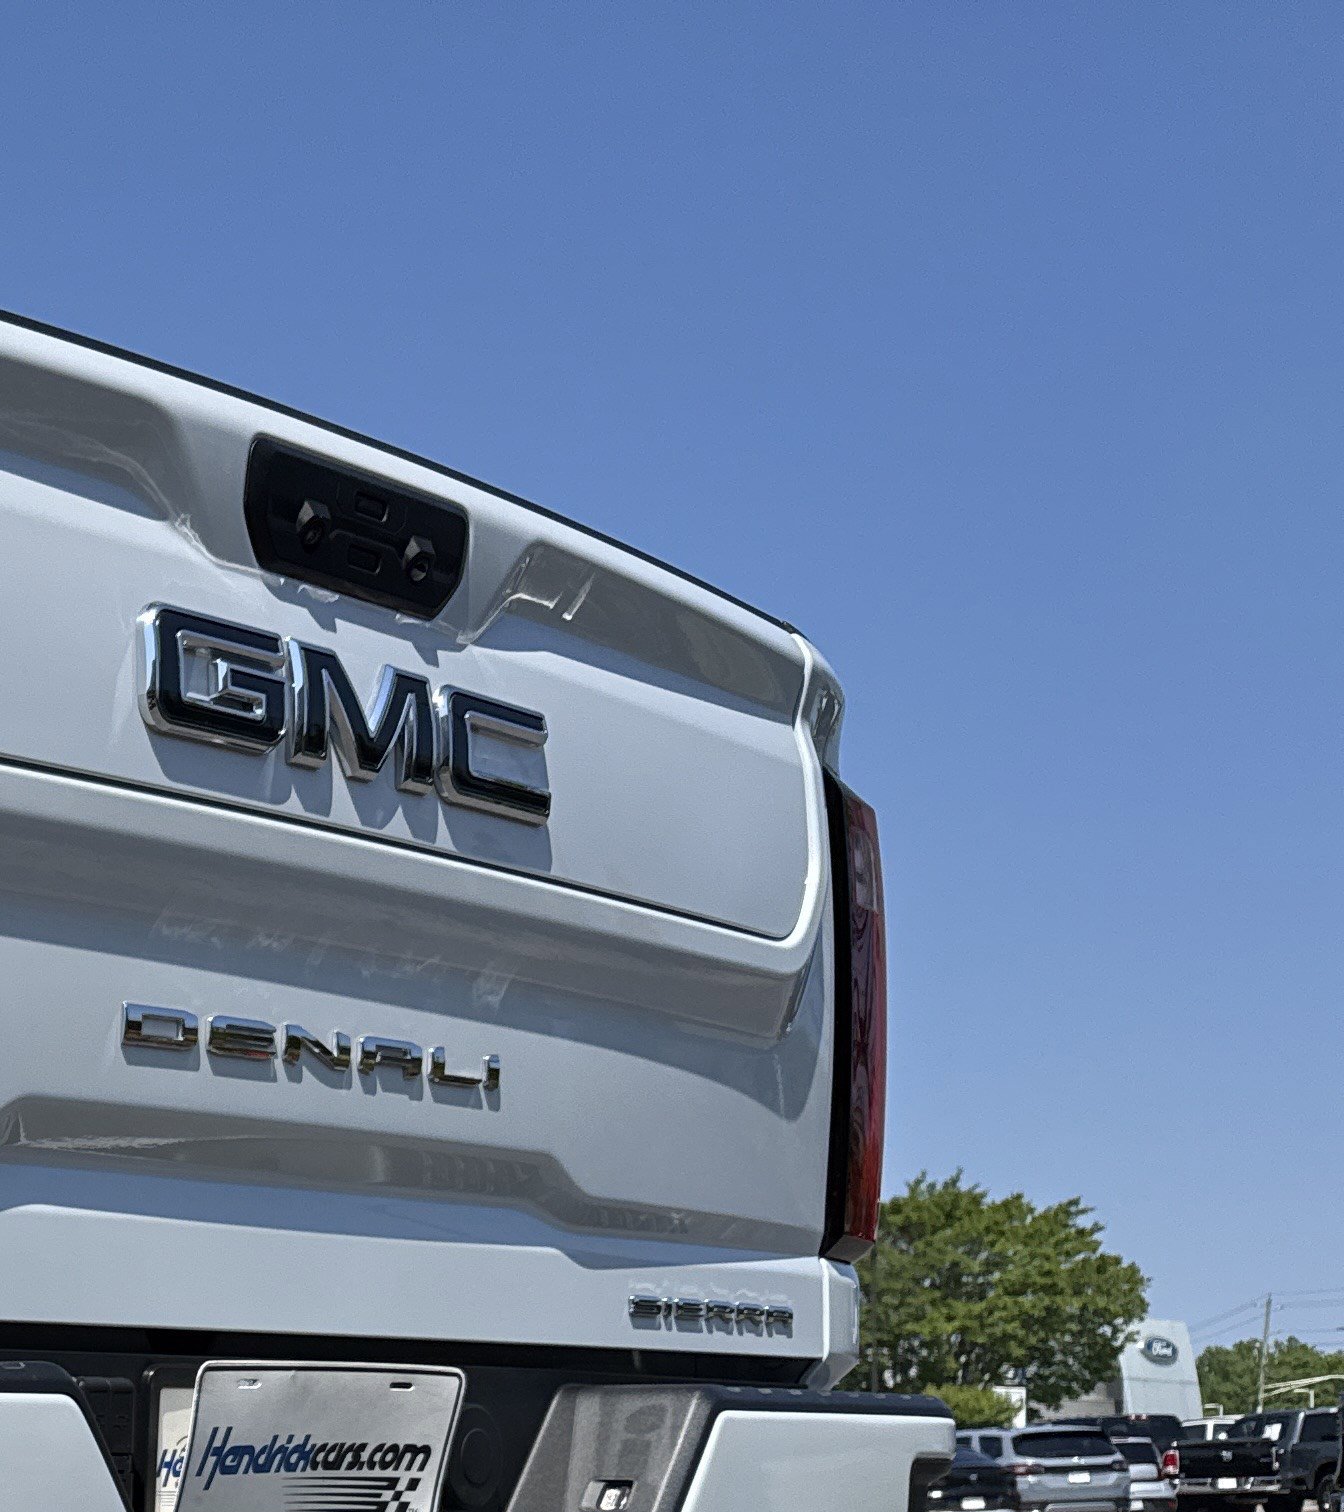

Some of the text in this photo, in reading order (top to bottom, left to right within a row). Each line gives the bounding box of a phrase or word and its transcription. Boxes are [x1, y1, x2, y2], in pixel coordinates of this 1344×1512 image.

[137, 601, 551, 826] GMC
[121, 1001, 500, 1091] DENALI
[628, 1294, 794, 1323] SIERRA
[195, 1426, 432, 1491] Hendrickcars.com
